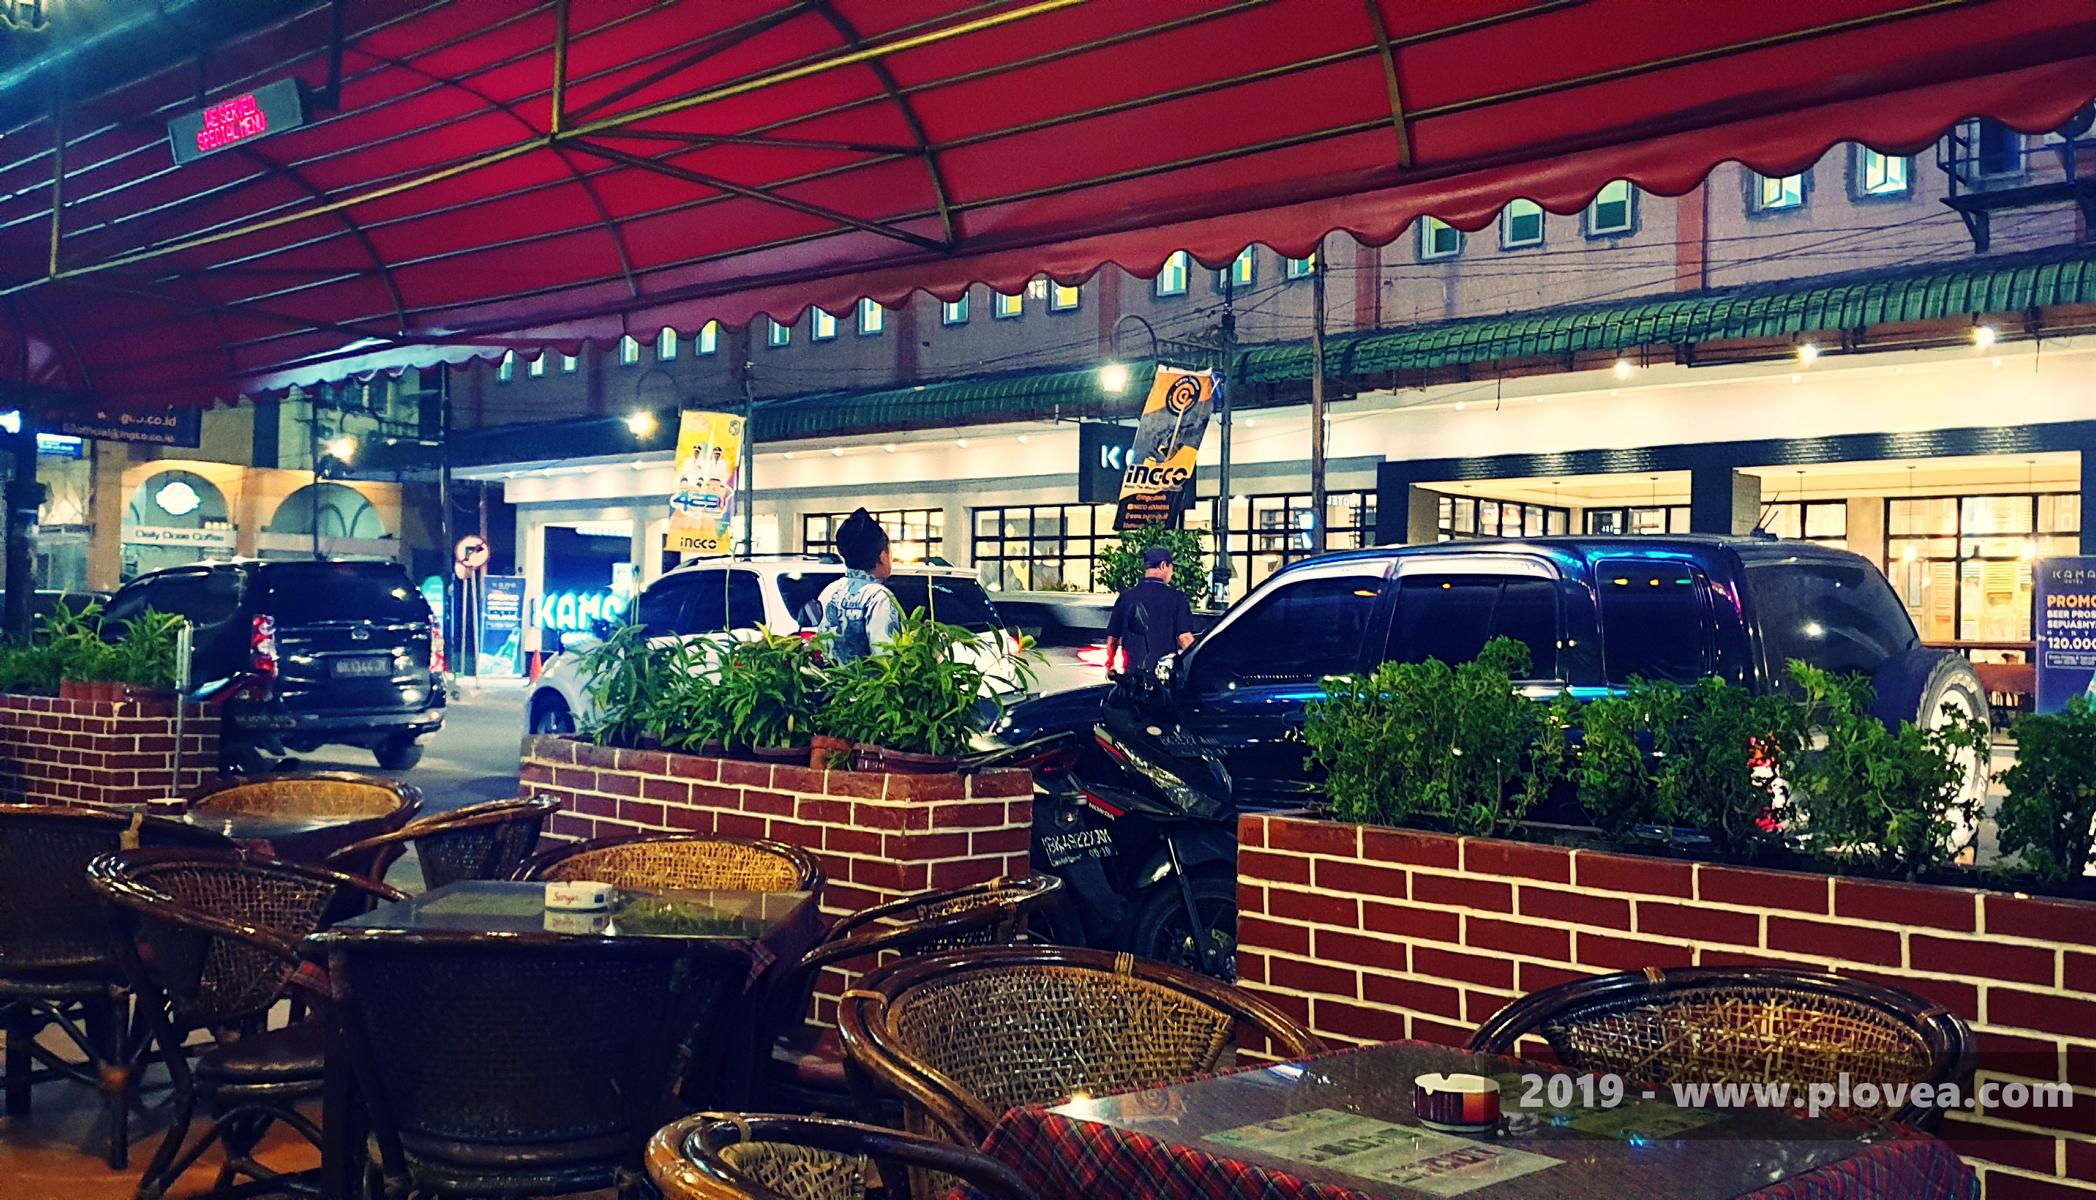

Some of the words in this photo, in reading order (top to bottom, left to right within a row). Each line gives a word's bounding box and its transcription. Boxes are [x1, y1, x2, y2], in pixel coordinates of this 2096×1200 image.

[197, 120, 240, 151] SPECIAL
[240, 112, 267, 138] MENU
[2046, 609, 2070, 619] BEER
[1088, 802, 1115, 821] HONDA
